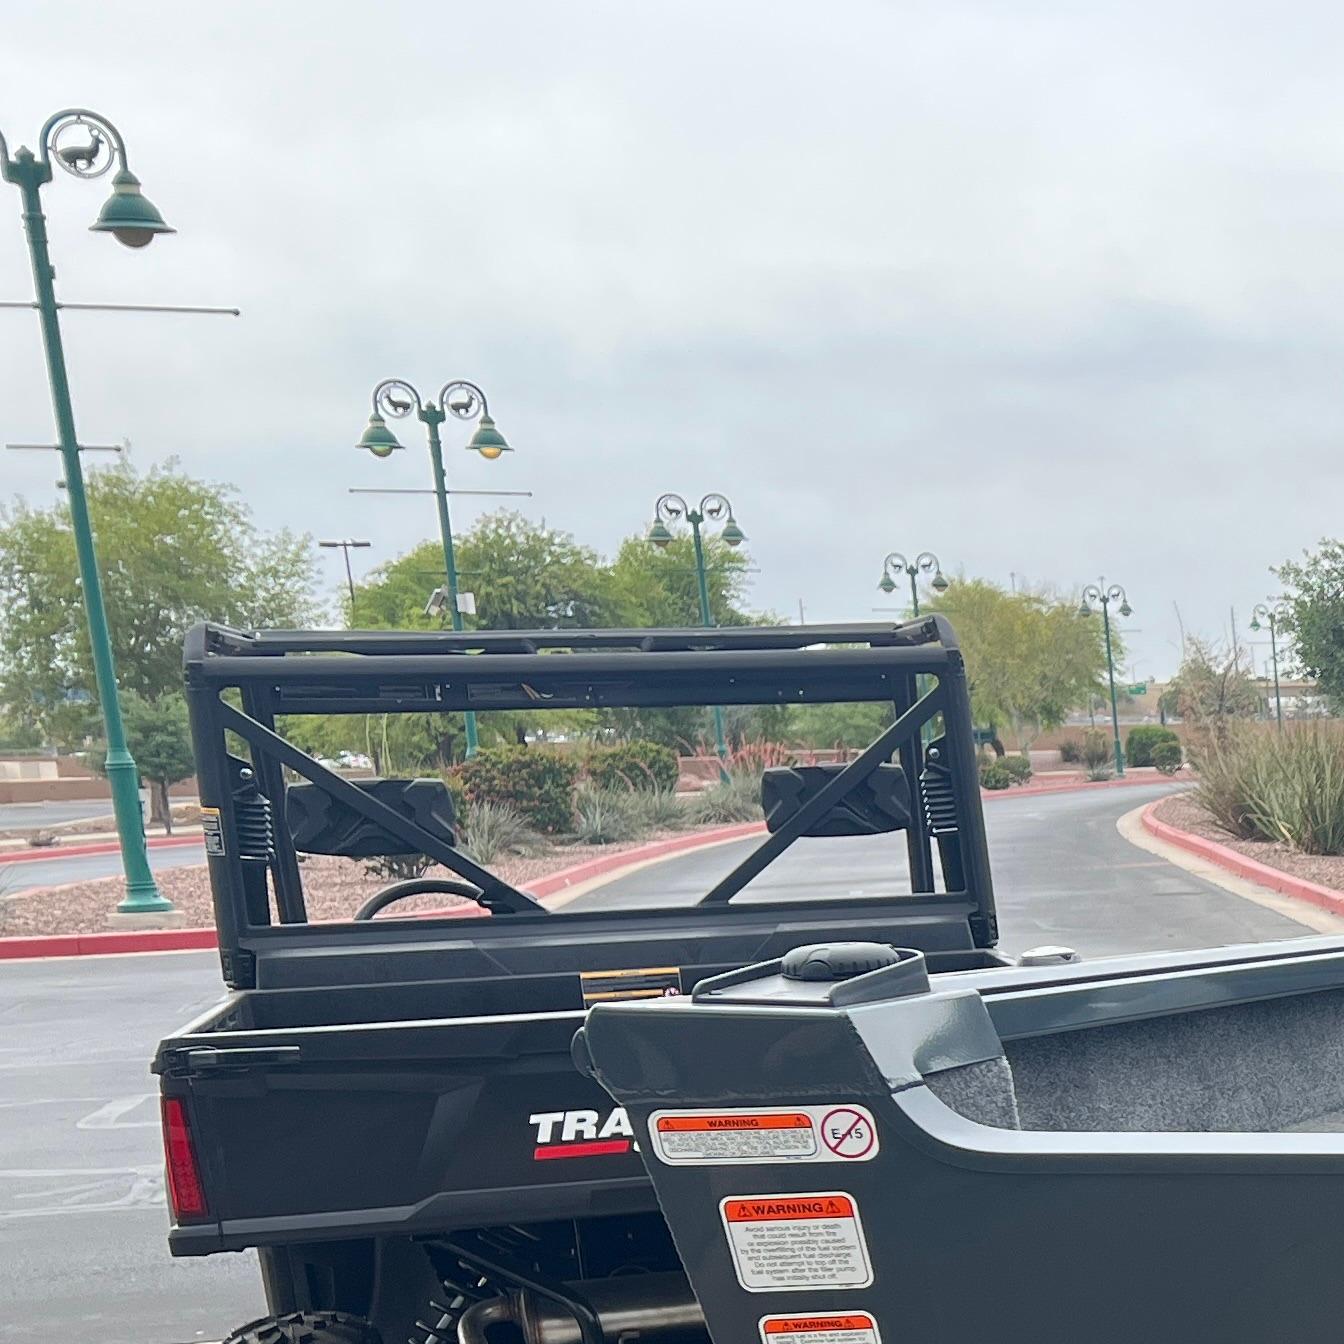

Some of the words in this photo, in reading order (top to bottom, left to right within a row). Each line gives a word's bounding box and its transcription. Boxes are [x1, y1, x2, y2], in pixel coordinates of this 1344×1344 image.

[707, 1119, 759, 1128] WARNING
[752, 1202, 823, 1215] WARNING
[792, 1320, 843, 1329] WARNING
